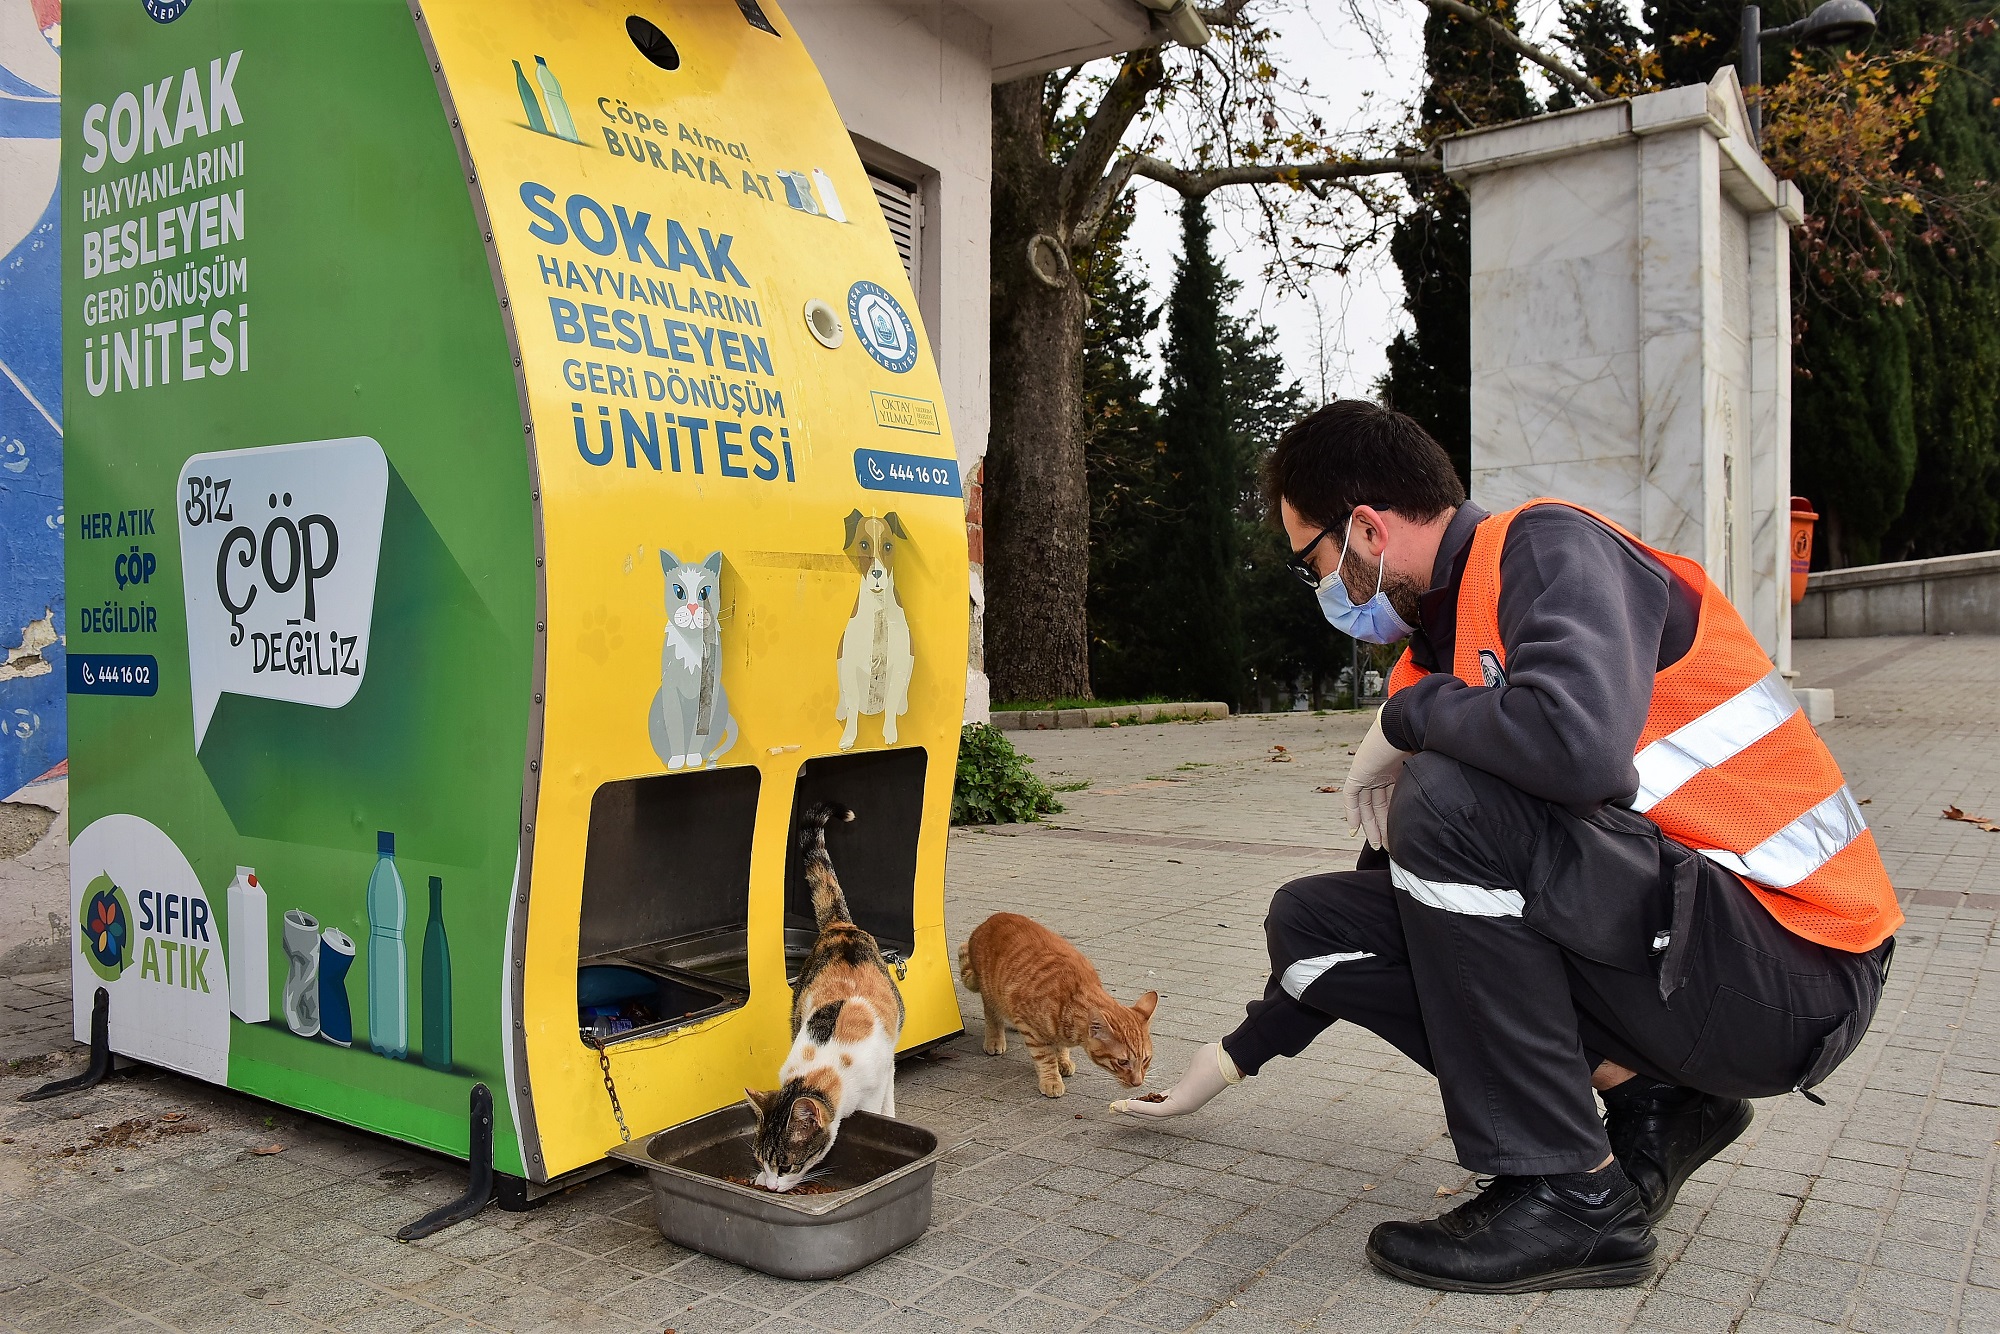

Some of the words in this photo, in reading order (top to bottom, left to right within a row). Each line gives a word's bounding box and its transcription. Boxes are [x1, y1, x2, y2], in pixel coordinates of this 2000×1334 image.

[82, 49, 245, 173] SOKAK
[597, 96, 669, 137] Çöpe
[678, 122, 751, 163] Atma!
[83, 140, 245, 222] HAYVANLARINI
[601, 126, 732, 190] BURAYA
[742, 169, 774, 202] AT
[83, 189, 245, 280] BESLEYEN
[518, 181, 751, 288] SOKAK
[83, 284, 130, 327] GERİ
[135, 255, 248, 316] DÖNÜŞÜM
[537, 254, 763, 328] HAYVANLARINI
[849, 287, 861, 326] BURSA
[862, 283, 912, 332] YILDIRIM
[84, 303, 249, 398] ÜNİTESİ
[548, 296, 775, 377] BESLEYEN
[562, 358, 638, 399] GERİ
[645, 367, 786, 419] DÖNÜŞÜM
[879, 410, 914, 426] YILMAZ
[881, 398, 910, 413] OKTAY
[572, 402, 796, 483] ÜNİTESİ
[889, 463, 914, 481] 444
[915, 466, 930, 483] 16
[932, 468, 949, 485] 02
[81, 512, 112, 540] HER
[116, 508, 156, 537] ATIK
[114, 545, 157, 591] ÇÖP
[216, 492, 339, 647] ÇÖP
[81, 601, 158, 633] DEĞİLDİR
[98, 666, 119, 683] 444
[120, 666, 133, 684] 16
[135, 666, 150, 684] 02
[138, 889, 210, 942] SIFIR
[140, 936, 211, 995] ATIK
